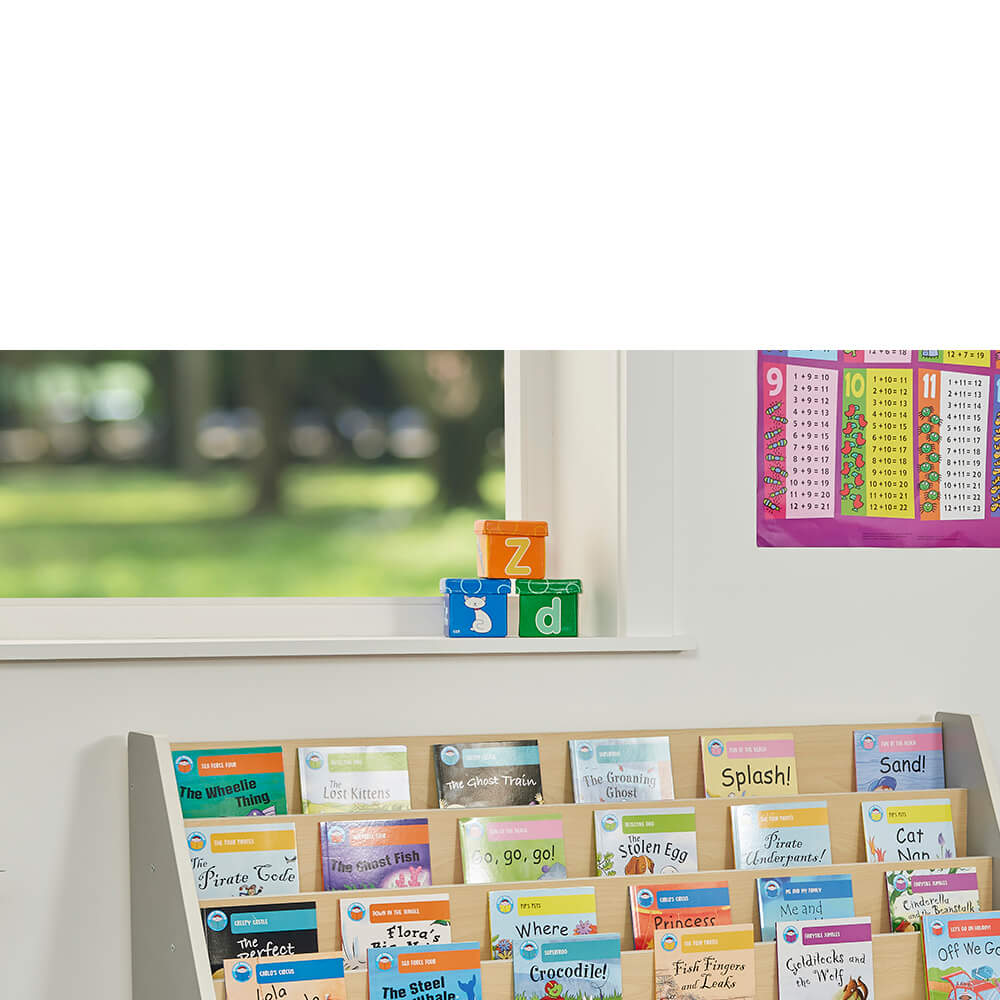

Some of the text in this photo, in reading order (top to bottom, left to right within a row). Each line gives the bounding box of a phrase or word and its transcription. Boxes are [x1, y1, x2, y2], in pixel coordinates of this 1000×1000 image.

[767, 368, 783, 396] 9
[845, 372, 864, 398] 10
[923, 373, 936, 398] 11
[535, 596, 561, 634] d
[880, 755, 926, 774] Sand!
[330, 780, 341, 788] The
[446, 774, 537, 790] The Ghost Train
[583, 771, 656, 787] The Groaning
[721, 765, 791, 790] Splash!
[180, 779, 256, 799] The Wheelie
[323, 786, 390, 799] Lost Kittens
[606, 785, 637, 798] Ghost
[235, 792, 270, 808] Thing
[628, 835, 640, 843] The
[764, 831, 803, 850] Pirate
[896, 828, 924, 845] Cat
[504, 848, 528, 865] go,
[533, 845, 555, 865] go!
[618, 840, 688, 864] Stolen Egg
[745, 848, 827, 866] Underpants!
[190, 857, 207, 869] The
[331, 850, 420, 873] The Ghost Fish
[198, 863, 295, 890] Pirate Code
[780, 901, 823, 916] Me and
[903, 894, 950, 910] Cinderella
[934, 902, 974, 914] Beanstalk
[515, 921, 568, 938] Where
[654, 916, 715, 930] Princess
[237, 938, 258, 949] The
[386, 926, 440, 943] Flora's
[237, 941, 295, 959] erfect
[938, 943, 961, 961] Off
[964, 942, 981, 955] We
[672, 956, 745, 977] Fish Fingers
[786, 949, 865, 975] Goldilocks and
[530, 963, 607, 982] Crocodile!
[797, 969, 844, 987] the Wolf
[382, 976, 446, 1000] The Steel
[681, 974, 736, 991] and Leaks
